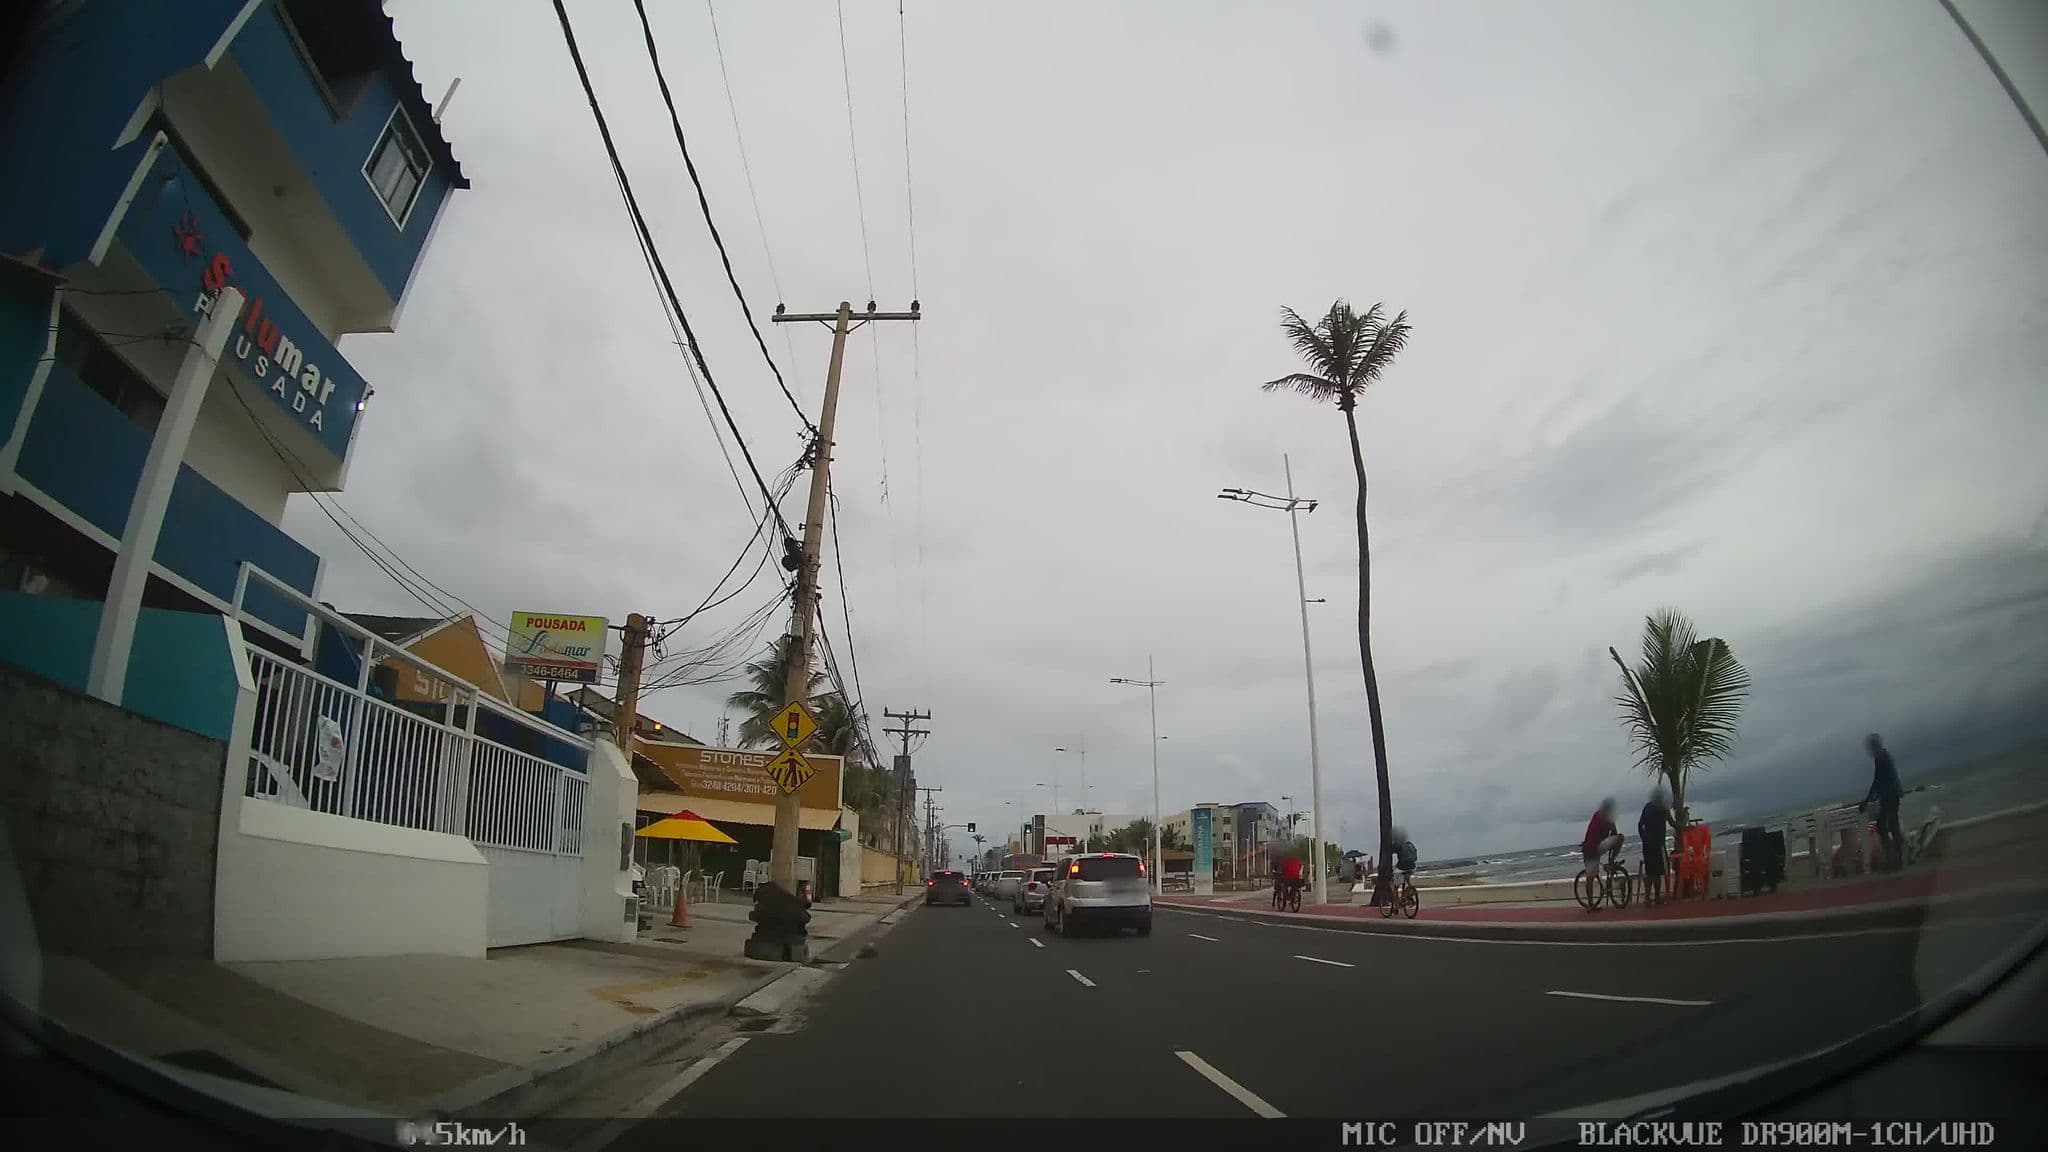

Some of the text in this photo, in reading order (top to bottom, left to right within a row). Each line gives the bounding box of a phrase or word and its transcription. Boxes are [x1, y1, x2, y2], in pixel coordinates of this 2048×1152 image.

[192, 291, 323, 432] PUSADA
[204, 253, 336, 406] Slumar
[526, 617, 586, 632] POUSADA
